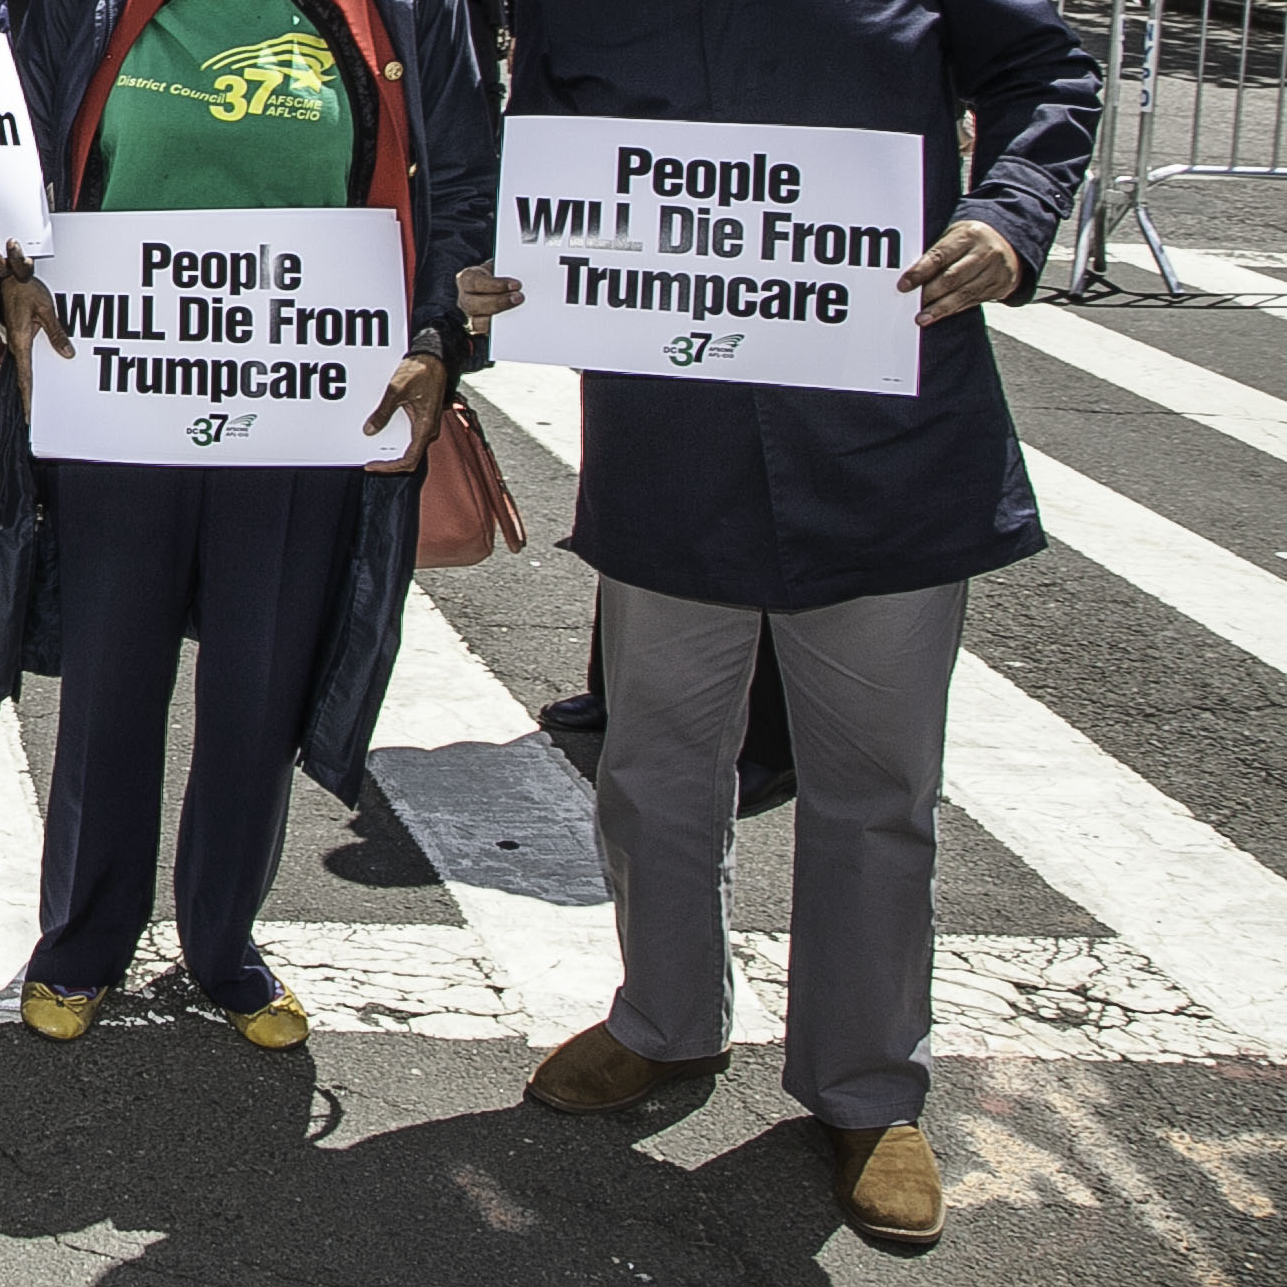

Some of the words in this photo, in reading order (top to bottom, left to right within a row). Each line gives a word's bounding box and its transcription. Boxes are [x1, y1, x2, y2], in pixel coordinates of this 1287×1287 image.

[116, 74, 166, 93] District
[170, 82, 227, 105] Council
[209, 67, 284, 122] 37
[265, 108, 321, 122] AFL-CIO
[266, 94, 323, 110] AFSCME
[616, 146, 802, 207] People
[515, 196, 643, 252] WILL
[658, 204, 744, 259] Die
[761, 210, 902, 270] From
[141, 242, 302, 296] People
[559, 254, 850, 325] Trumpcare
[55, 292, 166, 341] WILL
[179, 296, 254, 344] Die
[269, 298, 390, 347] From
[93, 346, 347, 404] Trumpcare
